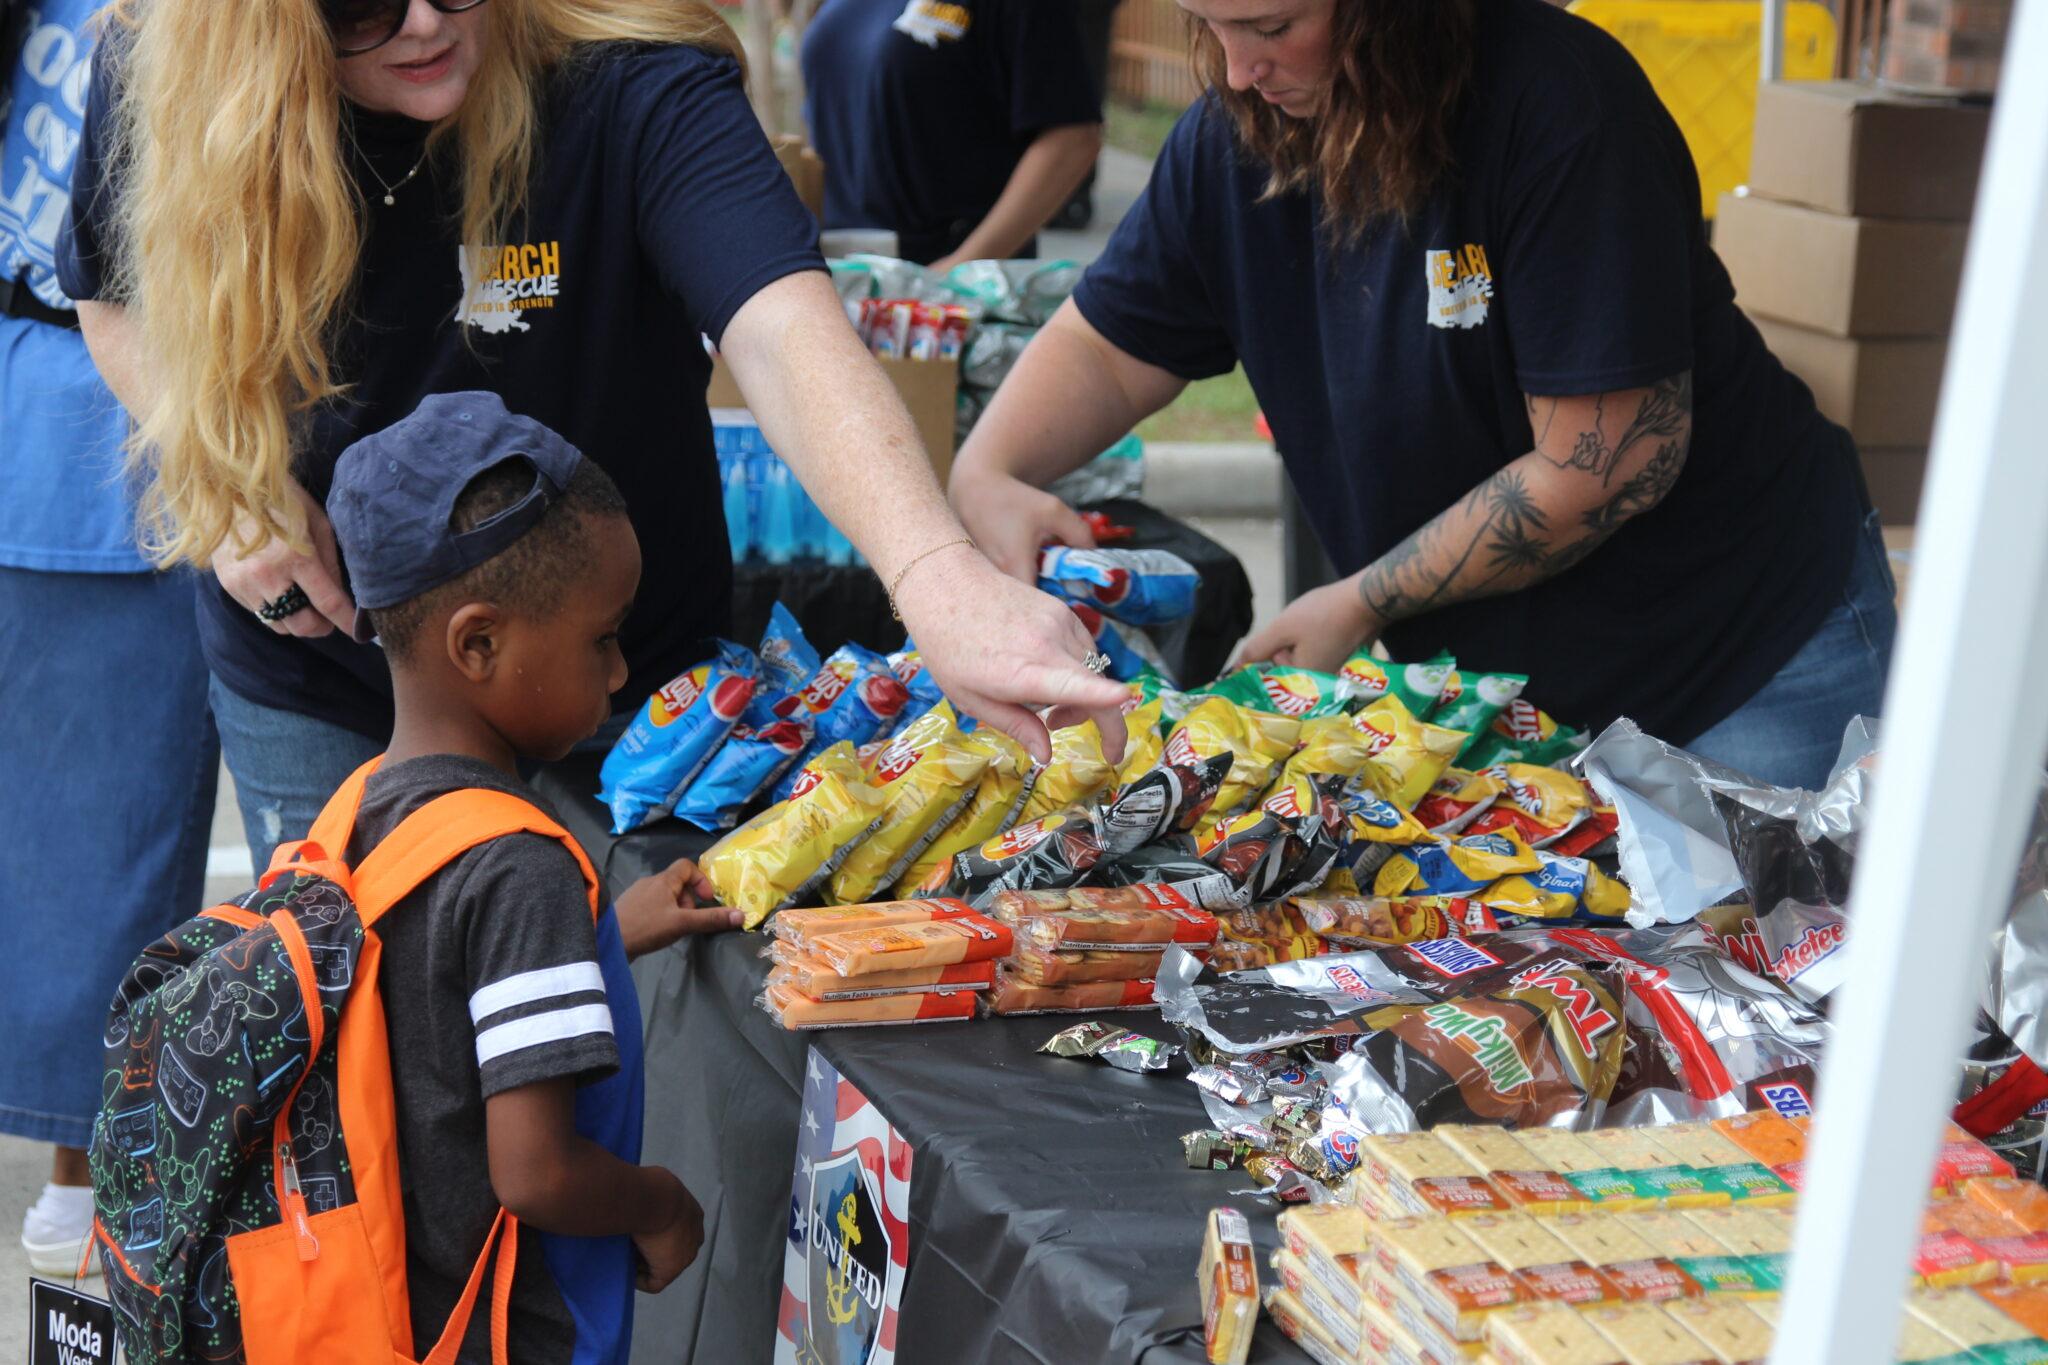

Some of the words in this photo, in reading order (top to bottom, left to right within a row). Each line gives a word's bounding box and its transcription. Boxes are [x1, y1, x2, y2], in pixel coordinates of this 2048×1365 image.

[480, 241, 560, 282] ARCH
[509, 297, 554, 312] STRENGTH
[661, 676, 700, 713] Lay's
[809, 670, 845, 704] ay's
[1503, 700, 1543, 744] ay's
[1000, 818, 1044, 851] Lay's
[1538, 867, 1581, 889] iginal
[1060, 940, 1091, 948] Nutrition
[1411, 938, 1494, 974] SNICKERS
[824, 992, 850, 1001] Nutrition
[852, 991, 869, 1000] Facts
[1512, 962, 1617, 1057] Twi
[1424, 1003, 1483, 1040] Wa
[1465, 1016, 1533, 1093] Milky
[1450, 1190, 1492, 1201] TOAST
[812, 1208, 882, 1311] UNITED
[49, 1309, 101, 1357] Moda
